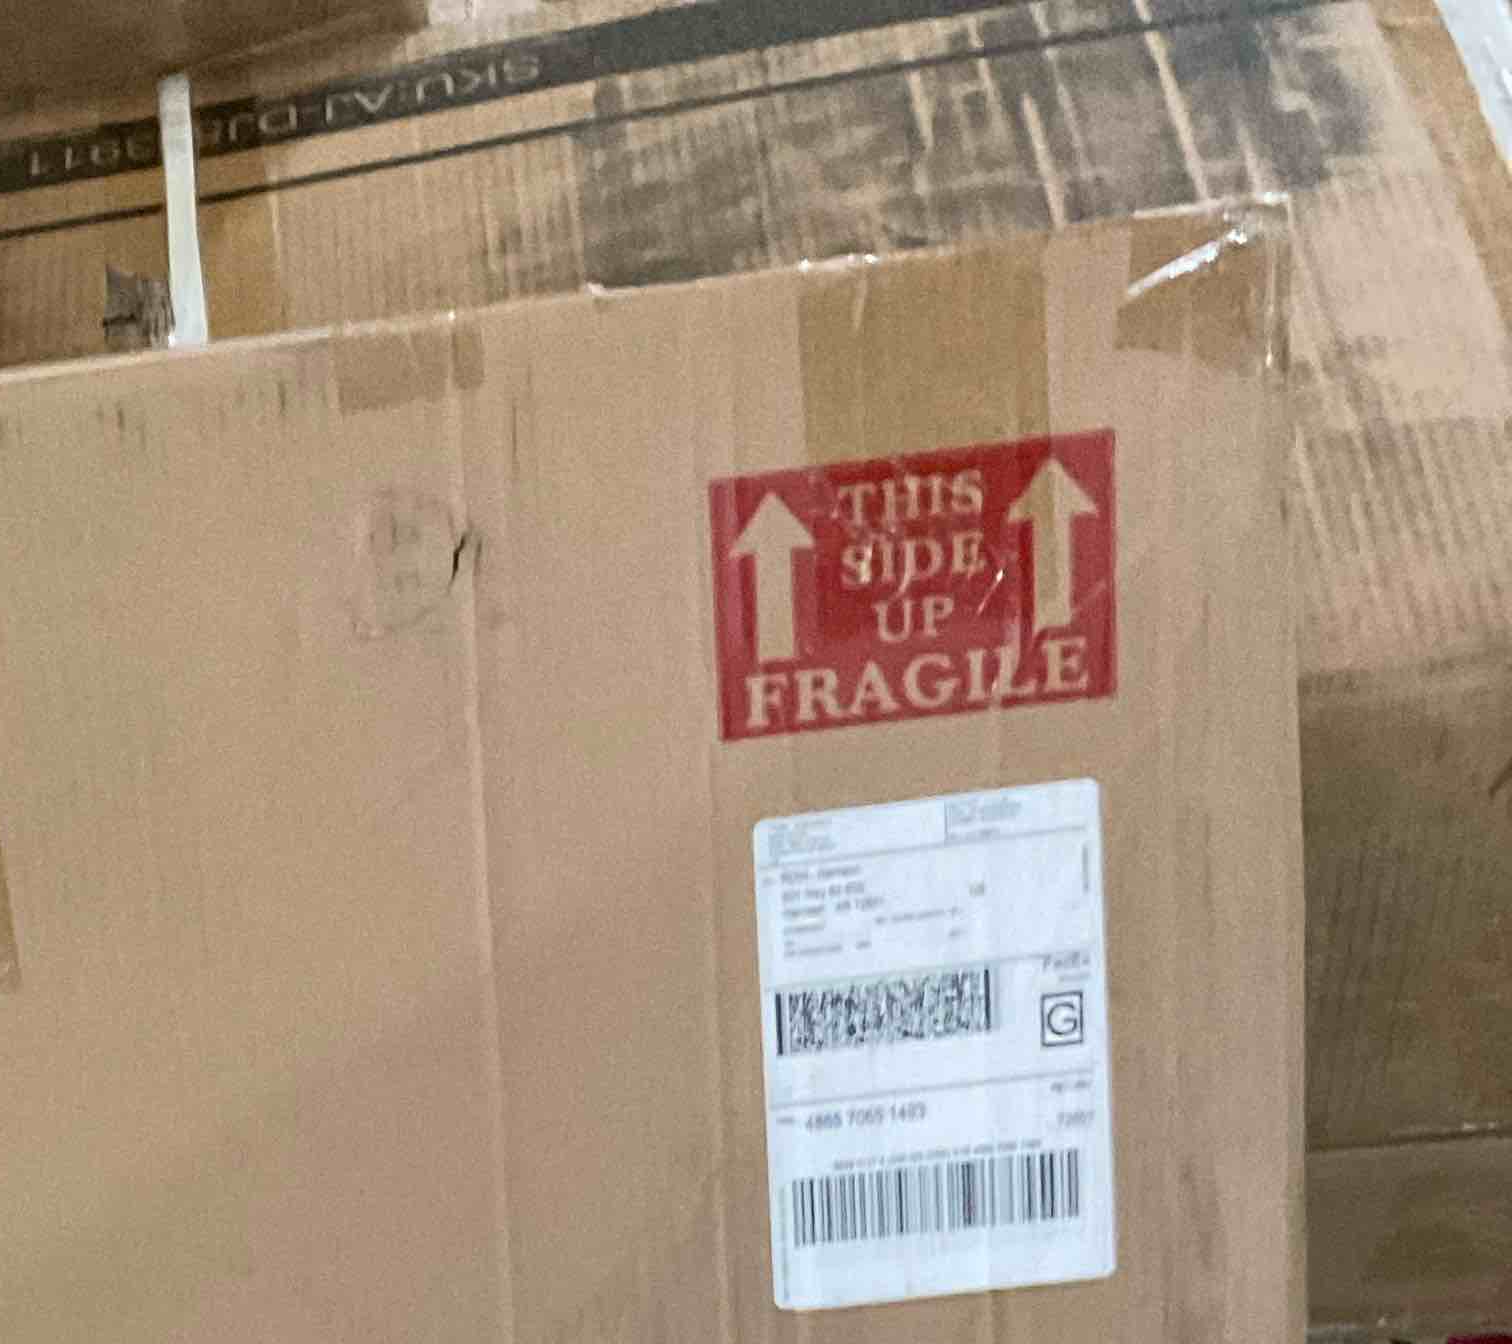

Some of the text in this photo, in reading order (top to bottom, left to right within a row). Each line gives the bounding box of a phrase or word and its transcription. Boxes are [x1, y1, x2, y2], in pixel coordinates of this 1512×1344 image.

[834, 469, 985, 527] THIS
[840, 532, 987, 588] SIDE
[872, 596, 954, 644] UP
[744, 636, 1090, 732] FRAGILE
[1047, 1002, 1079, 1037] G
